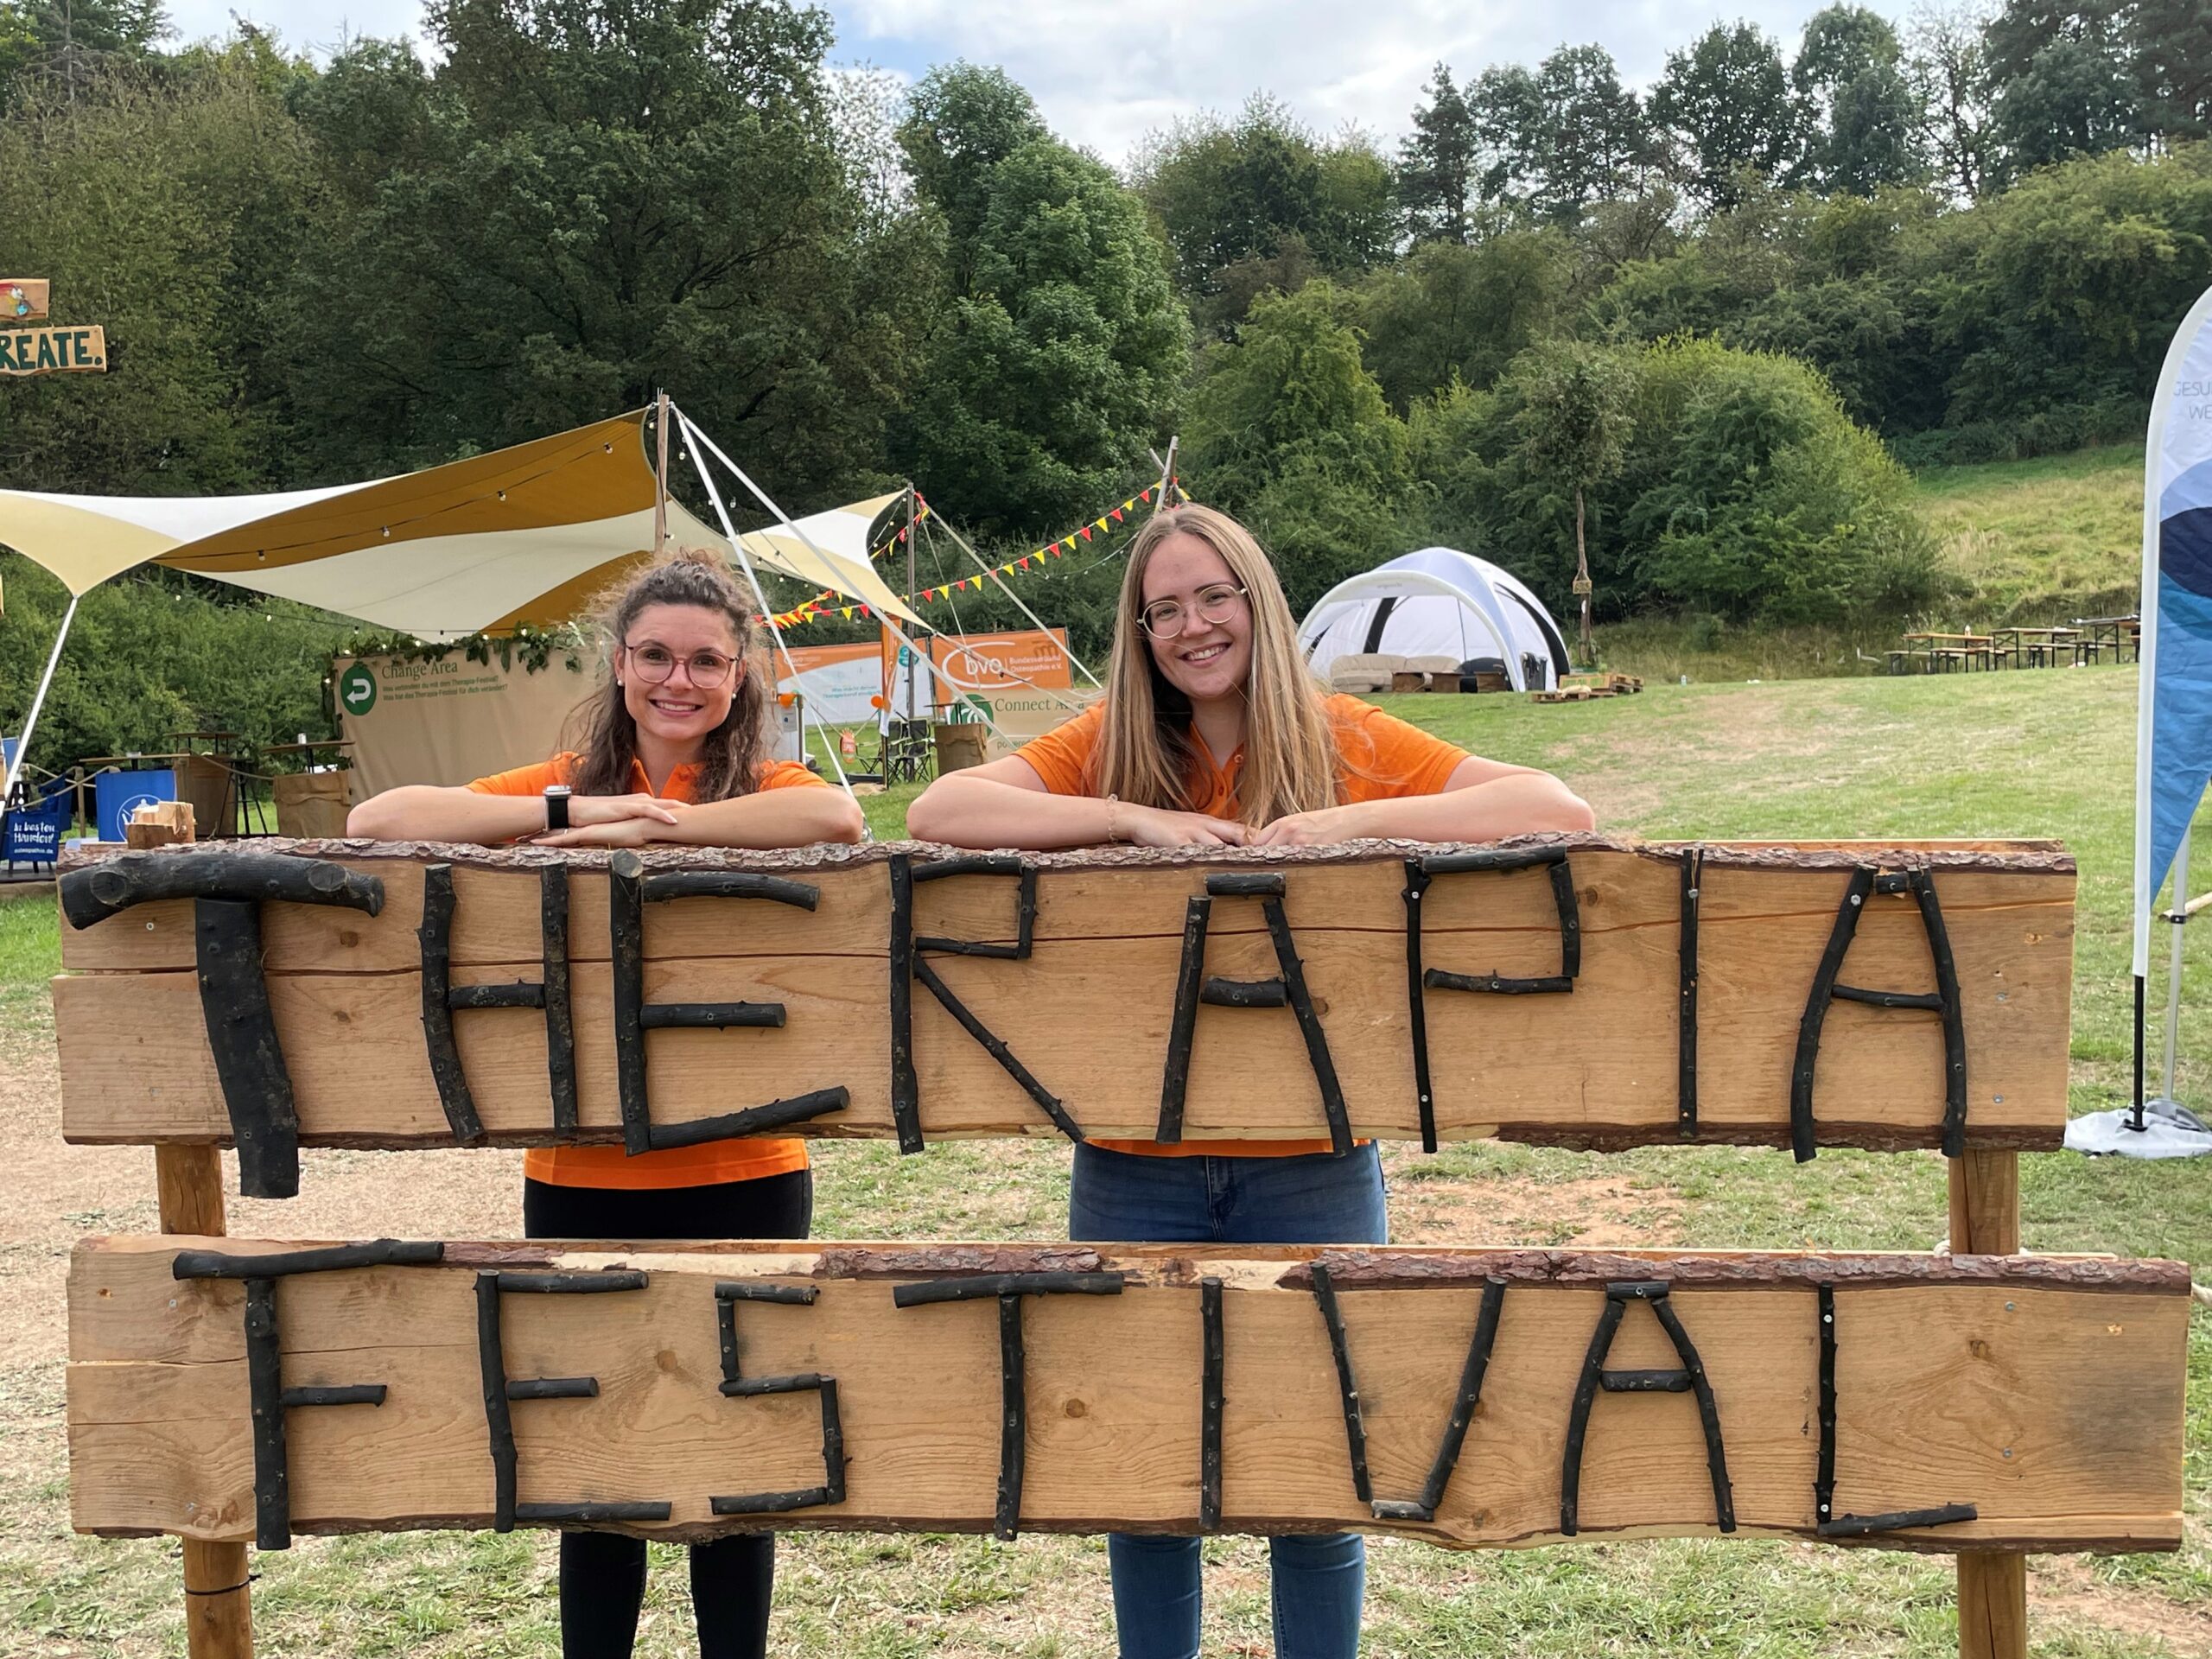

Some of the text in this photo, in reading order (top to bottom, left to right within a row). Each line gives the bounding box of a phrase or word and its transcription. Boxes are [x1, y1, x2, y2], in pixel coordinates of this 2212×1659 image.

[381, 661, 458, 681] Change Area
[964, 649, 1002, 676] bvo
[995, 698, 1051, 712] Connect
[58, 844, 1967, 1199] THERAPIA
[173, 1238, 1978, 1550] FESTIVAL
